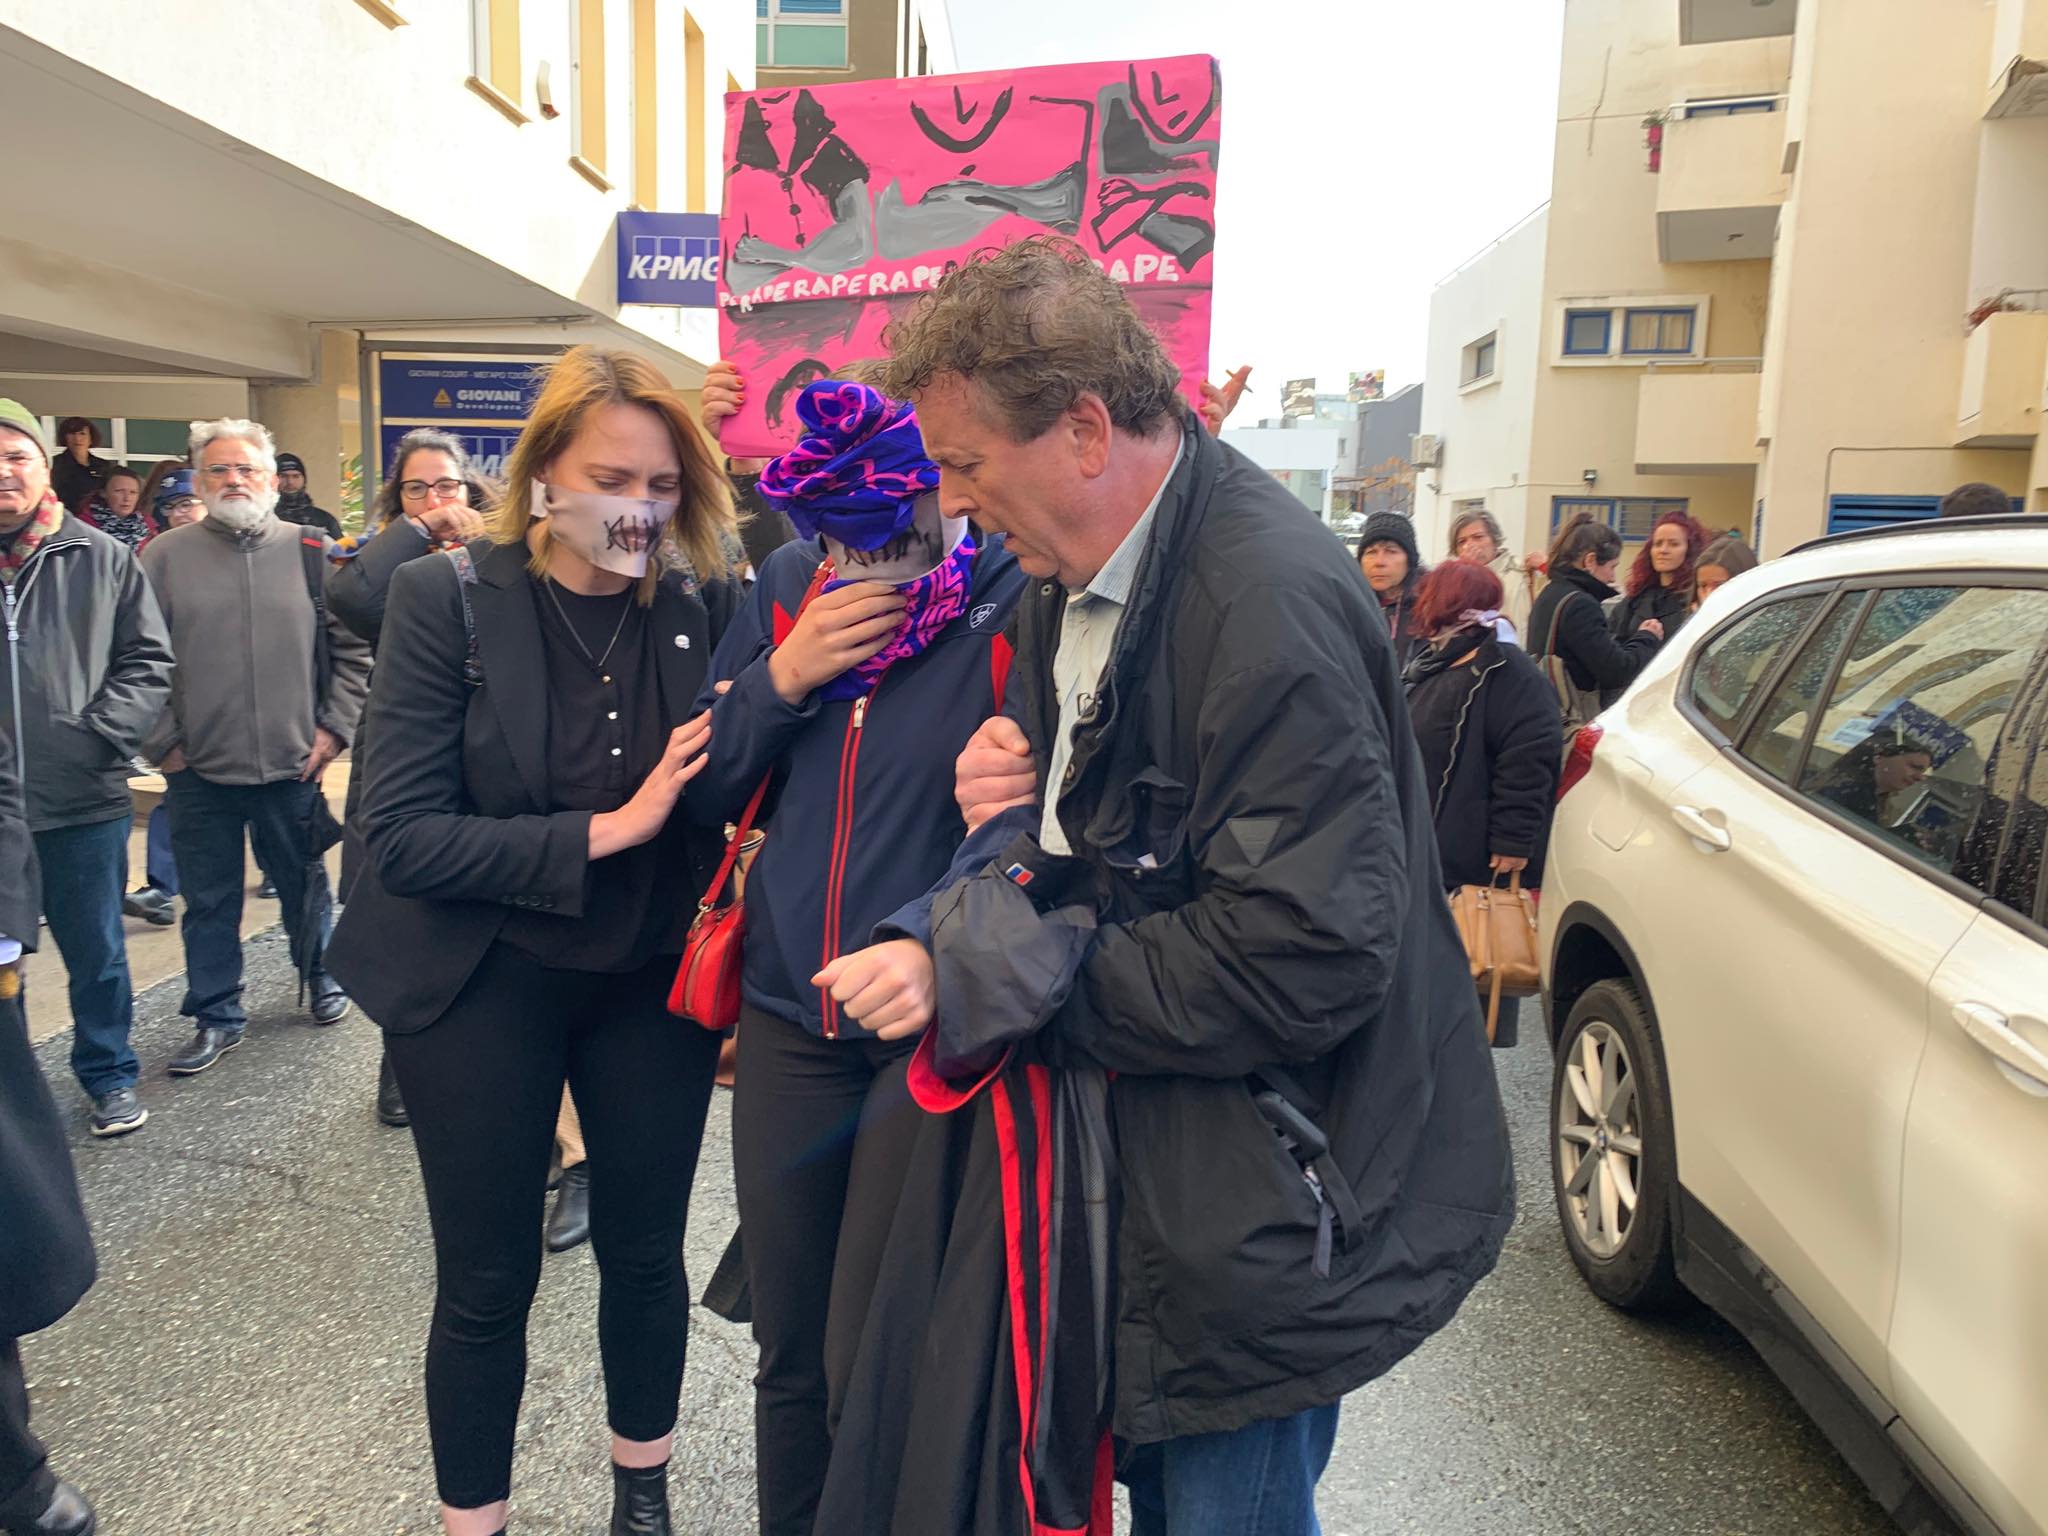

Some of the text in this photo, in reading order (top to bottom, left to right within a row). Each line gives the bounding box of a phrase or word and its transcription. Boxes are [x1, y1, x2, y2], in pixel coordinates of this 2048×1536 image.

[627, 255, 720, 281] KPMG
[793, 273, 867, 298] RAPE
[869, 266, 942, 295] RAPE
[457, 389, 521, 401] GIOVANI
[456, 402, 521, 411] Developers
